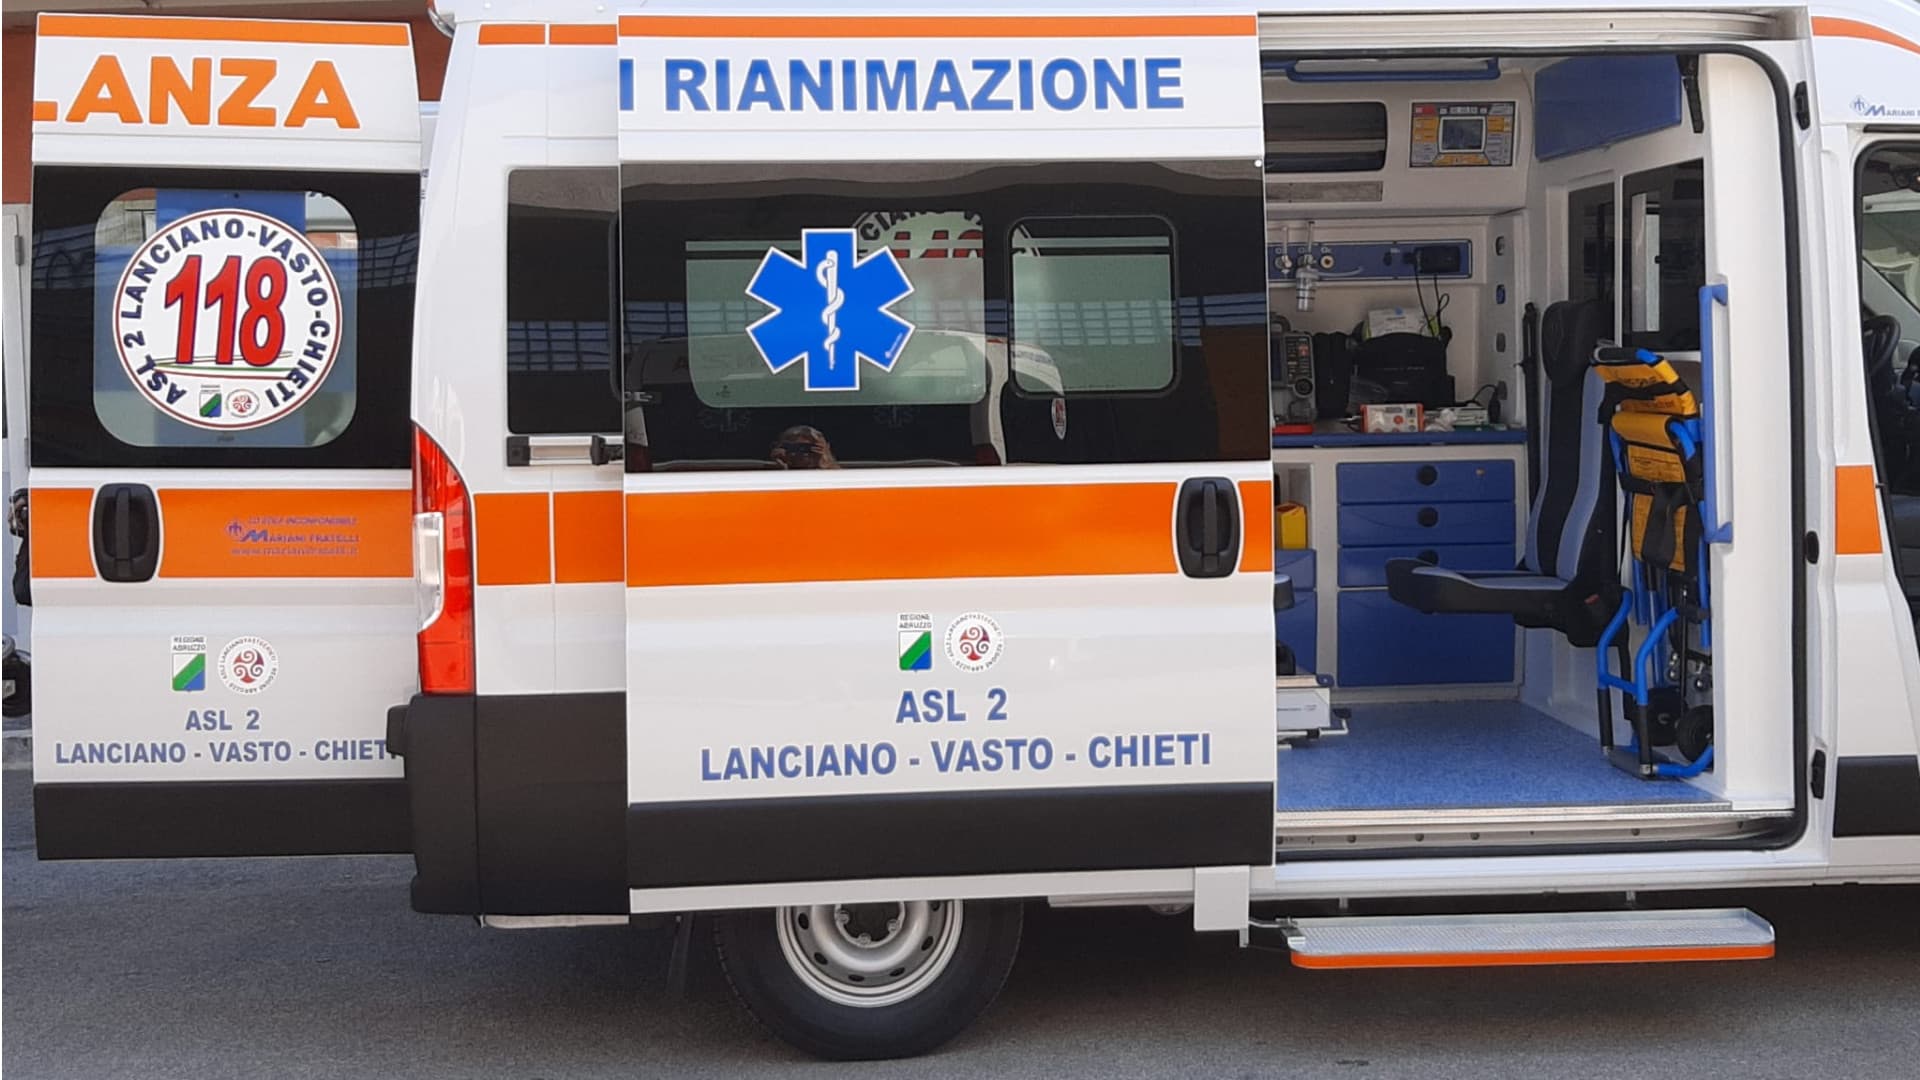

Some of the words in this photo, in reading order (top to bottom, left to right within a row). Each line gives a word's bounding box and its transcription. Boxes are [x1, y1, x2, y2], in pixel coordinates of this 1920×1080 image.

[665, 57, 1185, 111] RIANIMAZIONE
[164, 254, 288, 367] 118
[123, 330, 145, 349] 2
[137, 354, 187, 404] ASL
[240, 529, 305, 543] MARIANI
[185, 710, 232, 730] ASL
[245, 709, 260, 730] 2
[896, 689, 966, 723] ASL
[988, 688, 1007, 720] 2
[55, 742, 186, 763] LANCIANO
[209, 741, 291, 762] VASTO
[315, 739, 396, 761] CHIET
[702, 742, 896, 781] LANCIANO
[931, 737, 1053, 773] VASTO
[1088, 733, 1210, 769] CHIETI
